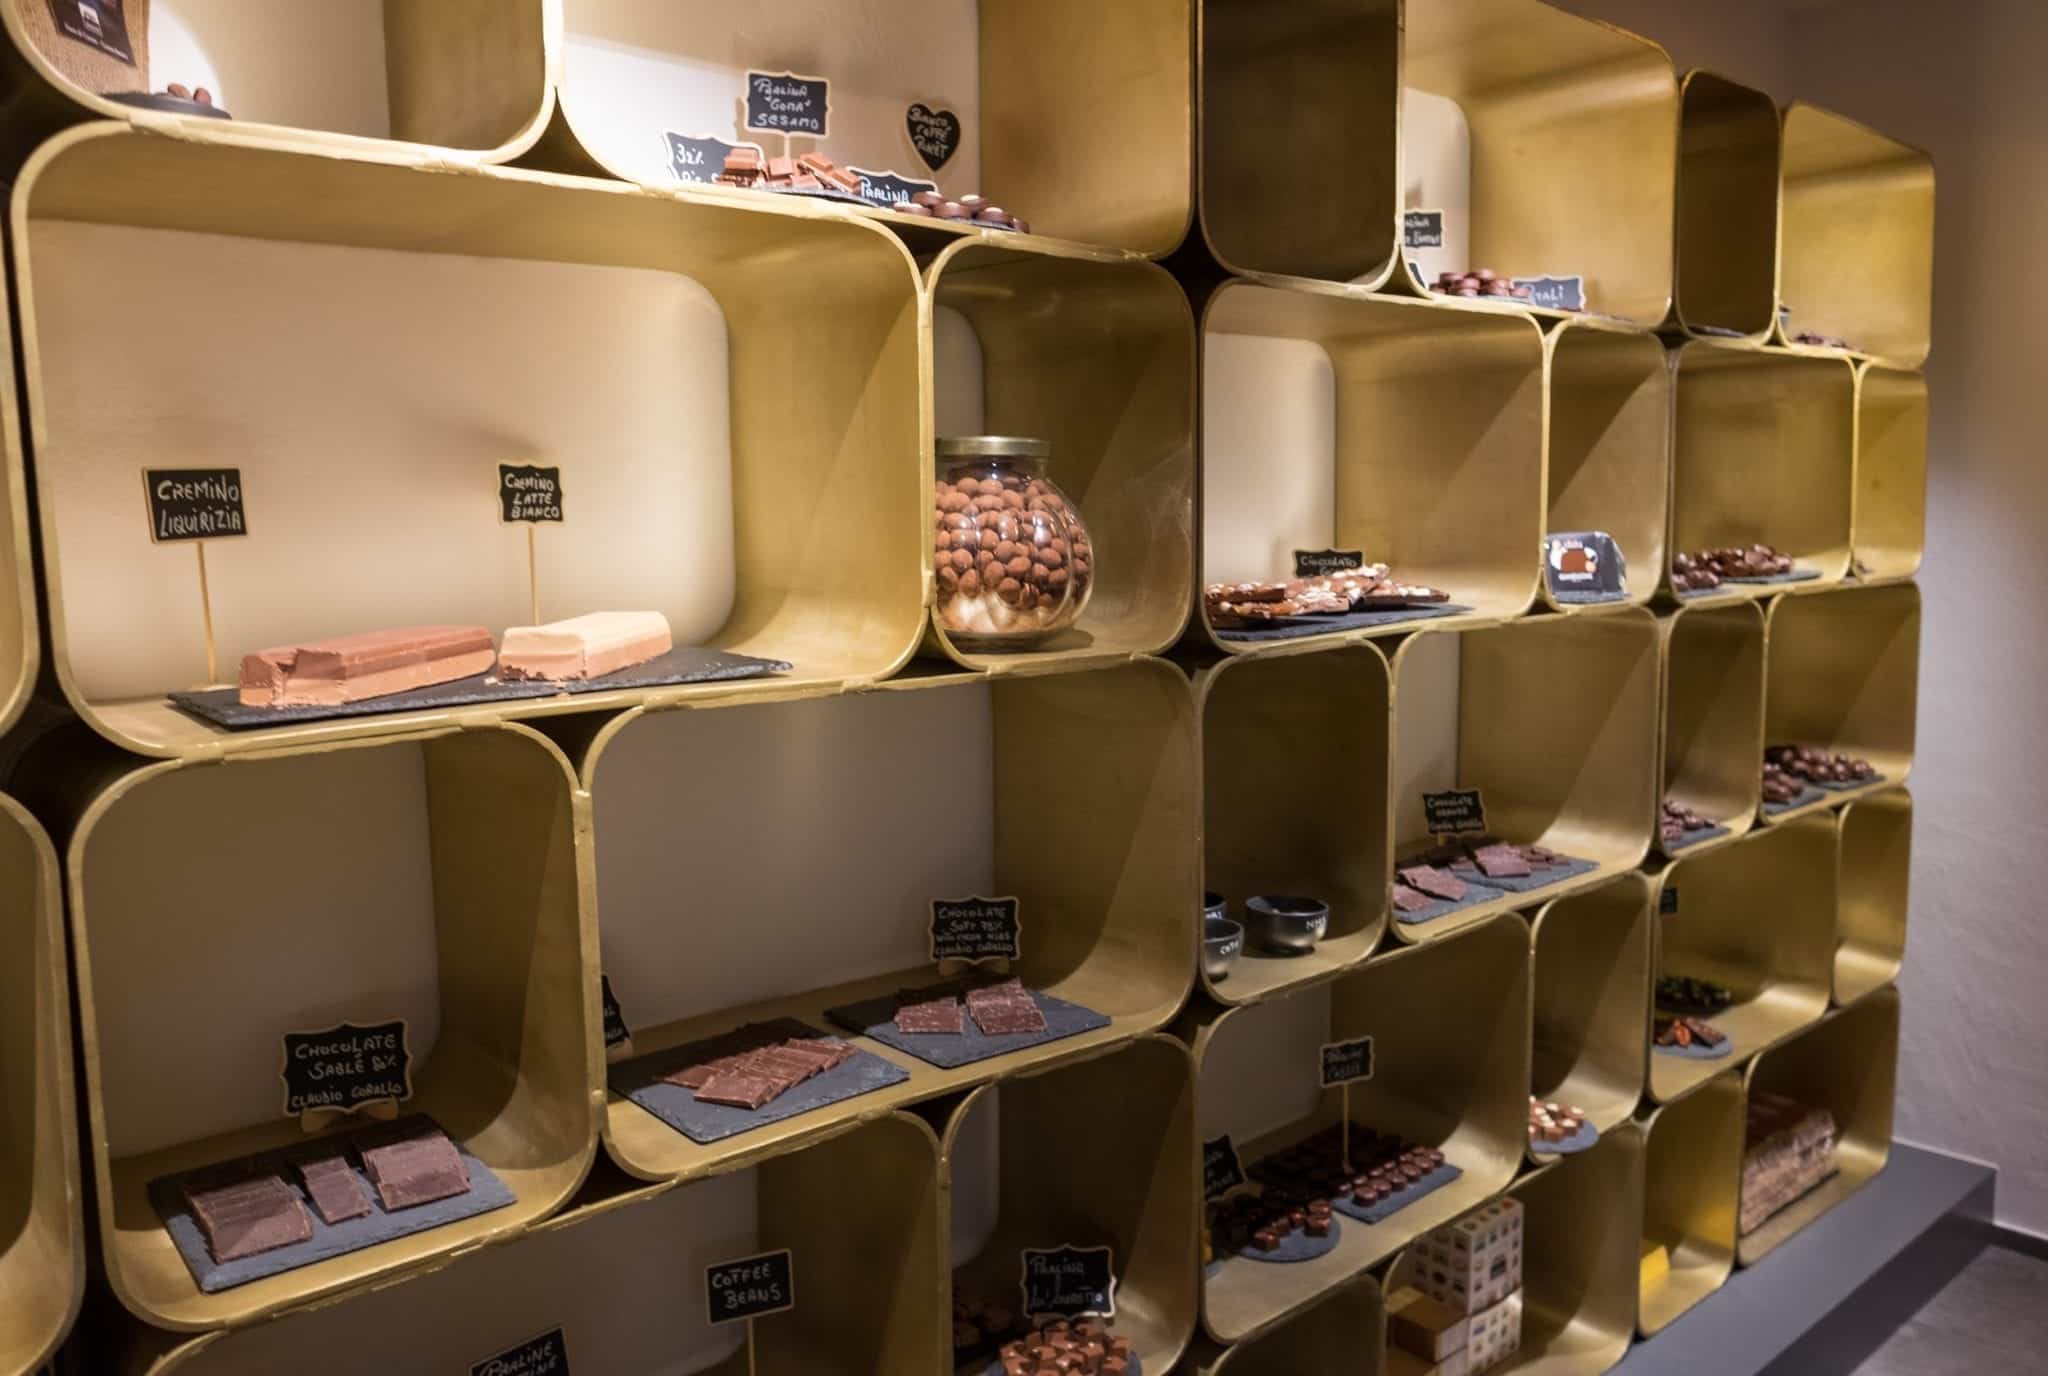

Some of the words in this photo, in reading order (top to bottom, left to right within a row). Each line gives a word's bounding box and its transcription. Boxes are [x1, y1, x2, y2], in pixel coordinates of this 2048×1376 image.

[157, 475, 240, 502] CREMINO
[504, 472, 554, 492] CREMINO
[513, 492, 553, 505] LATTE
[160, 505, 242, 538] LIQUIRIZIA
[511, 506, 560, 519] BIANCO
[295, 1034, 395, 1059] CHOCOLATE
[712, 1263, 771, 1288] COFFEE
[724, 1283, 781, 1309] BEANS
